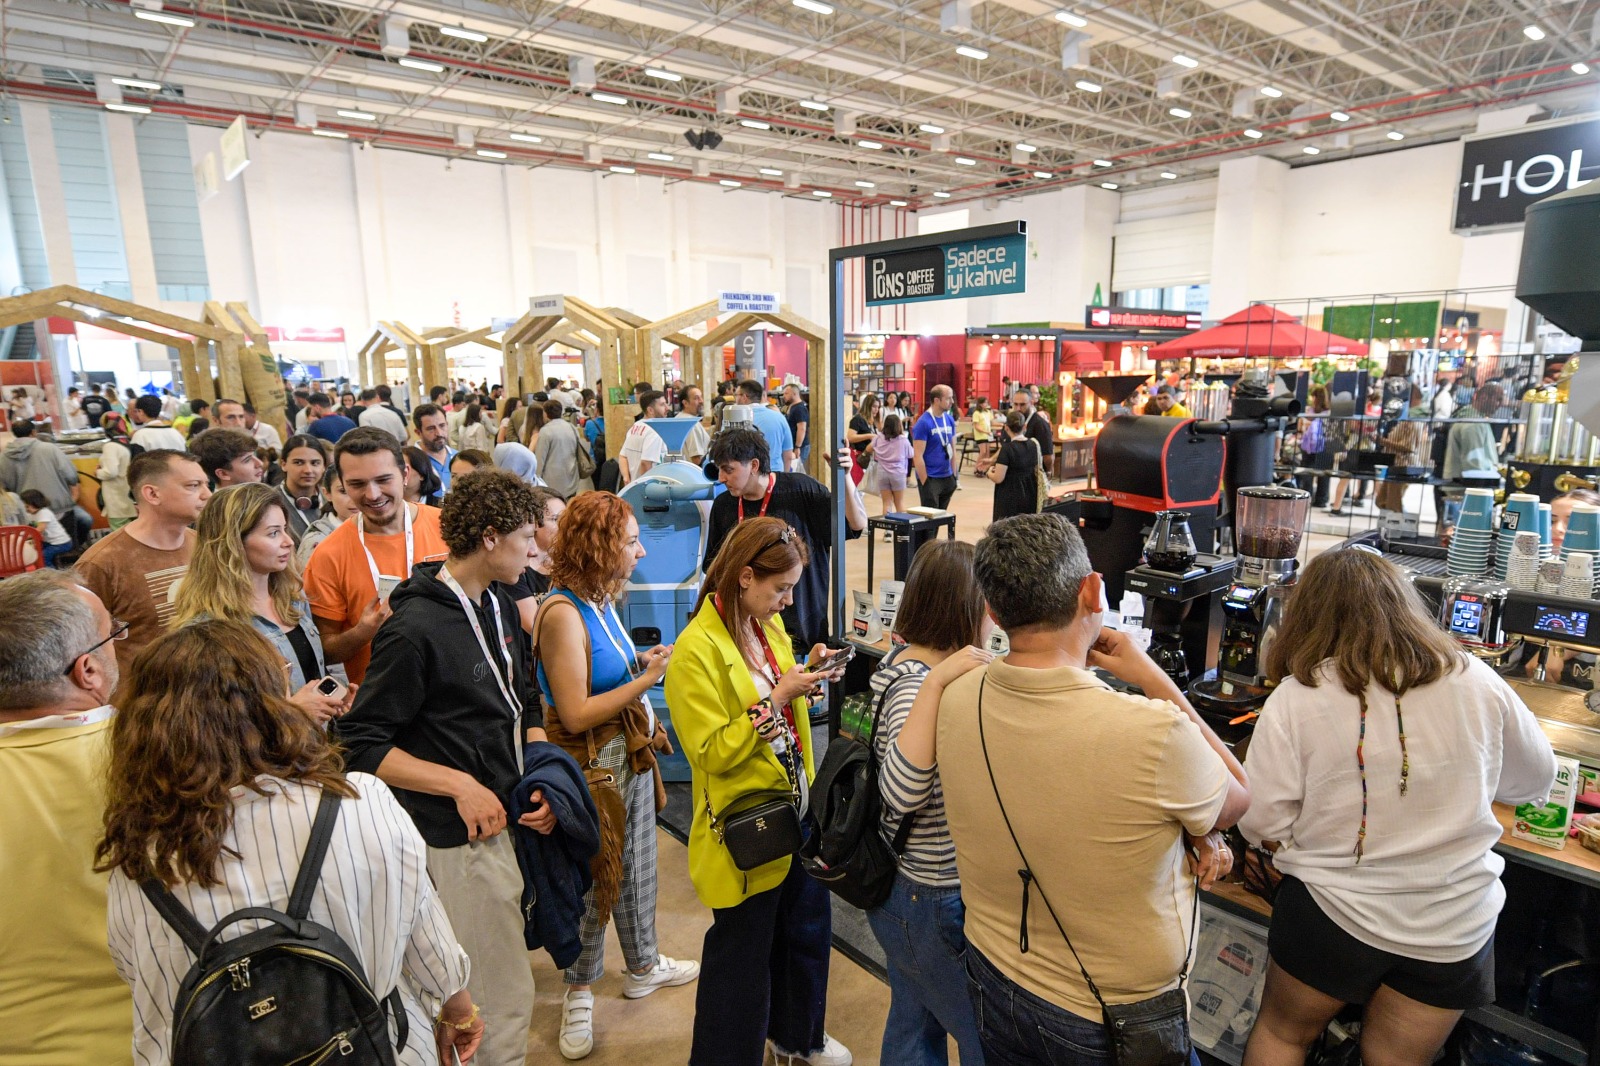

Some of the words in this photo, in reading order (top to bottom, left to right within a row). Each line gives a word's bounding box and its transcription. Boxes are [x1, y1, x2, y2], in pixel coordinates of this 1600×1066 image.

[947, 245, 1006, 269] Sadece
[872, 258, 904, 299] PONS
[906, 268, 935, 284] COFFEE
[947, 269, 963, 295] iyi
[965, 262, 1017, 288] kahve!
[722, 293, 751, 301] FRIENDZONE
[906, 283, 935, 296] ROASTERY
[749, 303, 773, 311] ROASTERY
